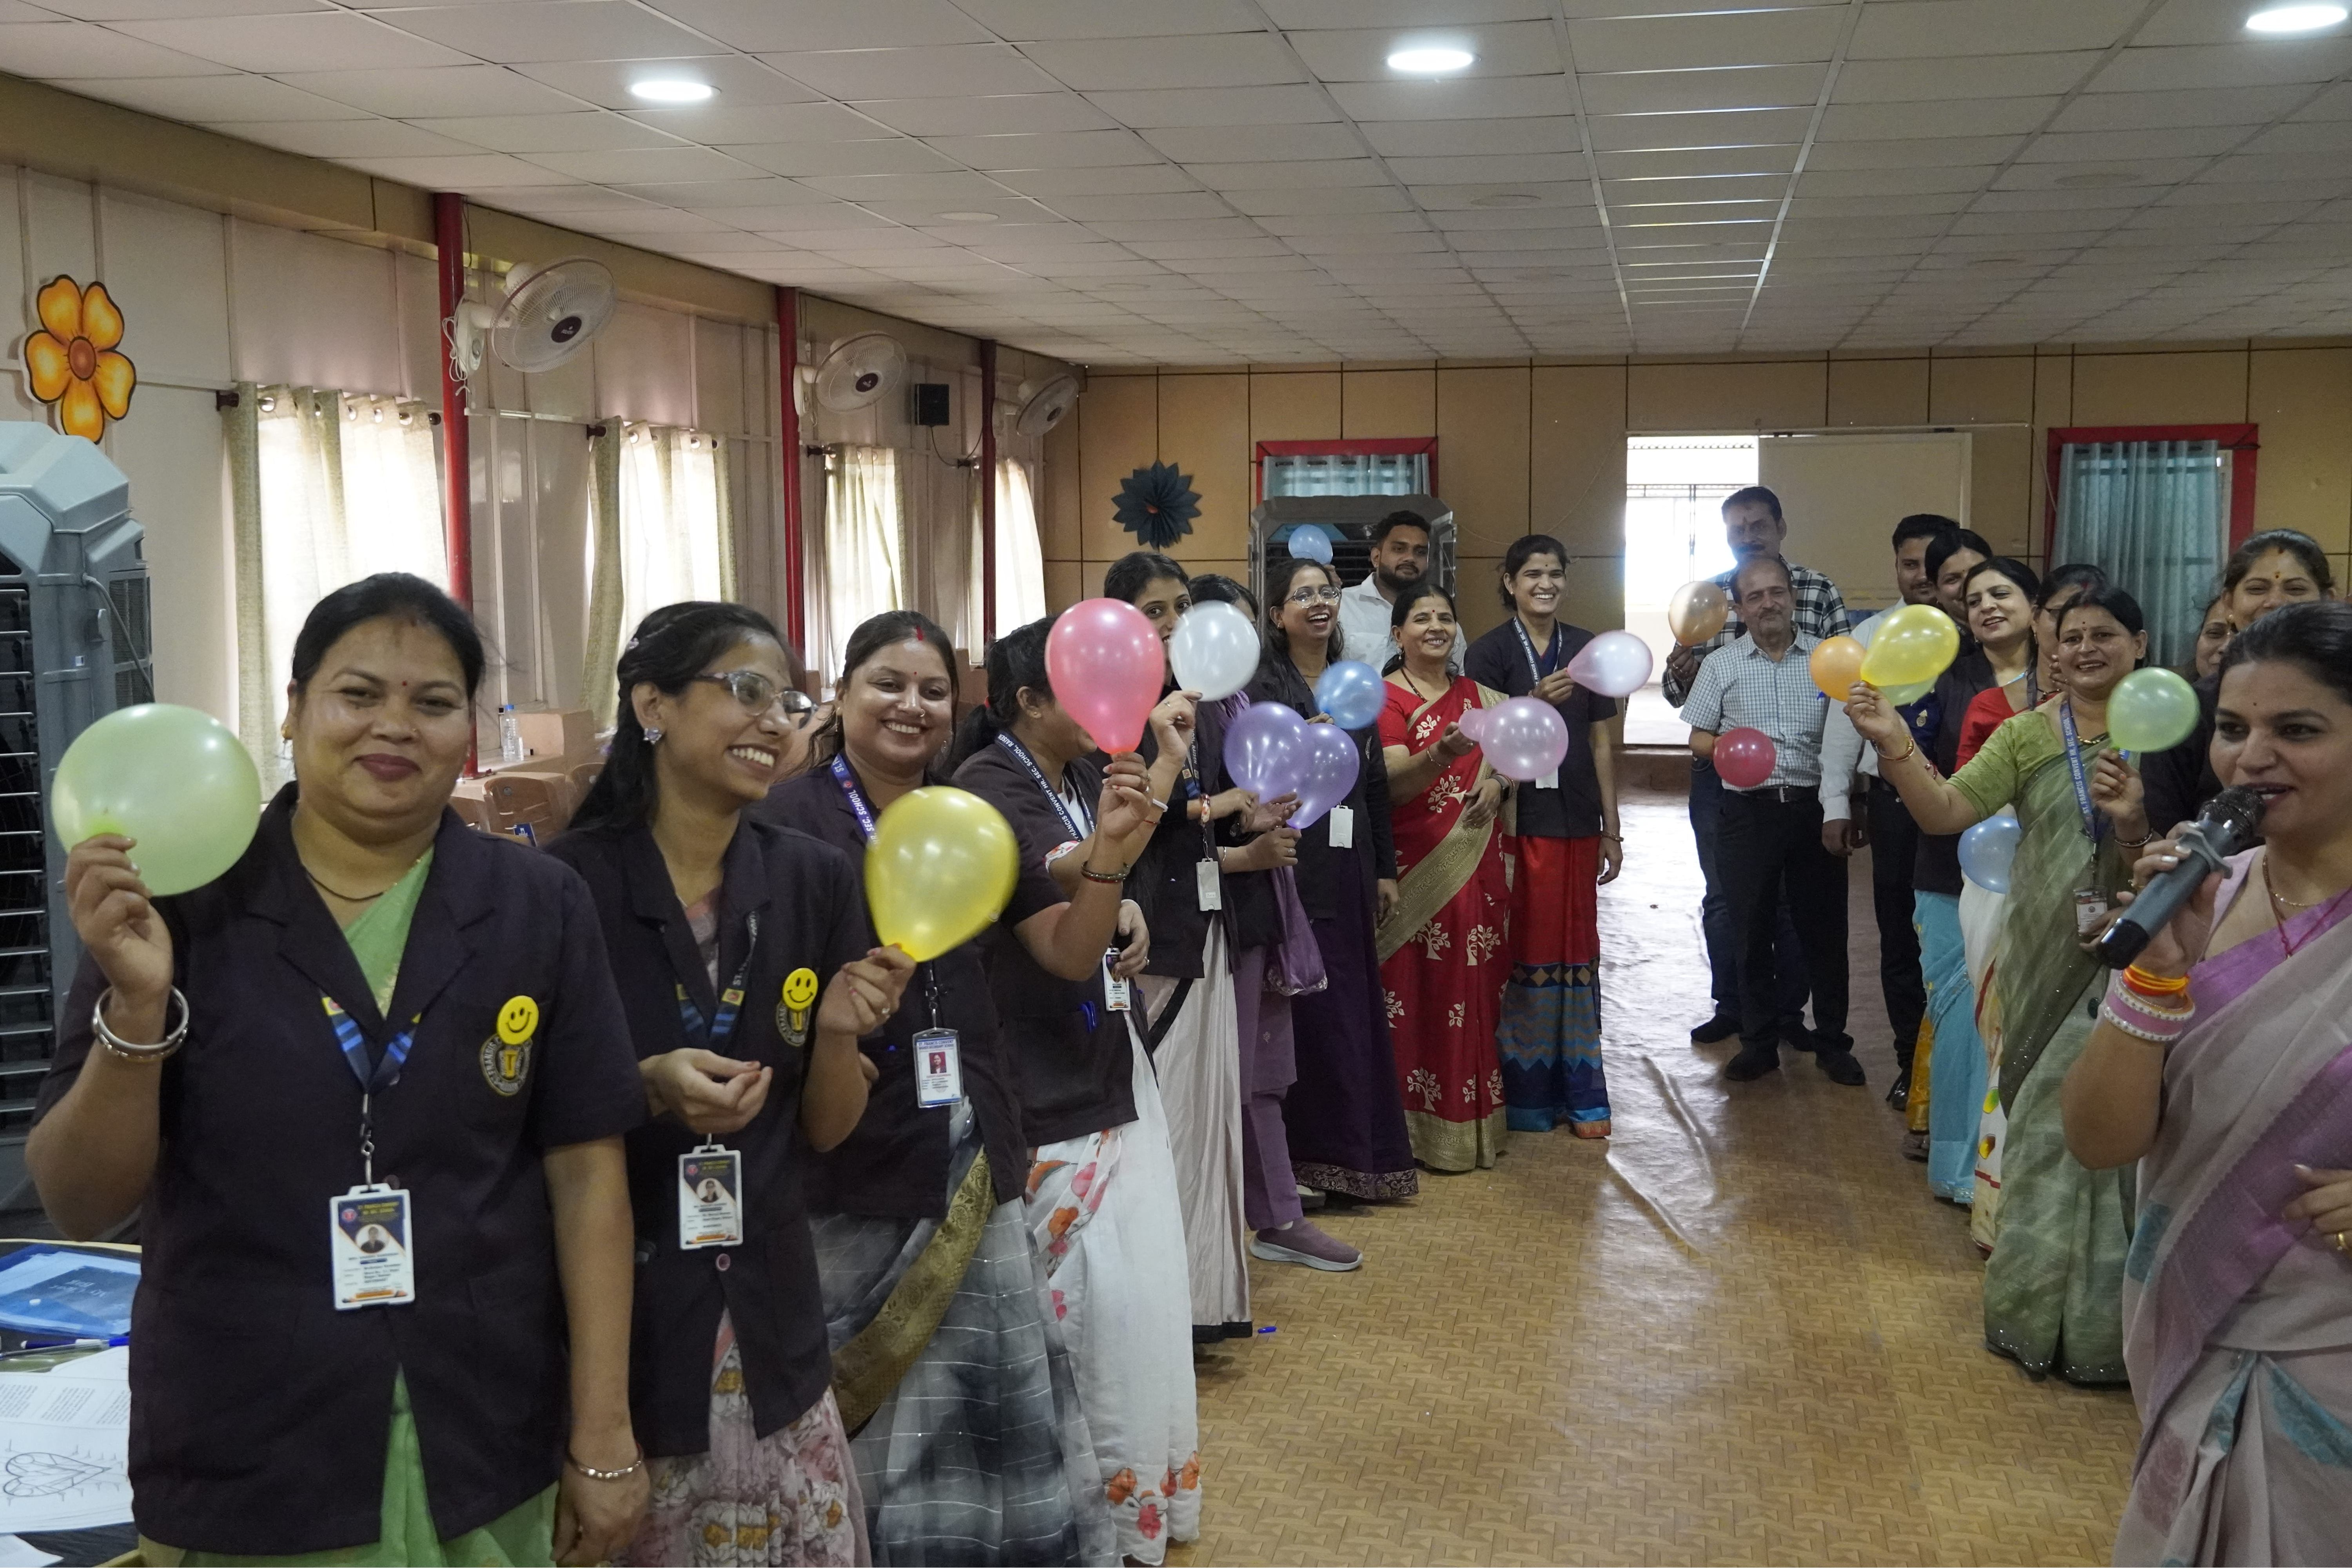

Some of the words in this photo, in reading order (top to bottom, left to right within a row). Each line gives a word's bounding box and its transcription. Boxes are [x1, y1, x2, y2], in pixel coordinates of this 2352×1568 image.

[1526, 645, 1534, 663] CONVENT
[2063, 717, 2073, 735] SCHOOL
[998, 733, 1014, 748] RAISEN
[1013, 745, 1033, 766] SCHOOL,
[834, 763, 844, 773] ST.
[1031, 766, 1041, 779] SEC.
[2071, 757, 2081, 780] CONVENT
[2077, 781, 2086, 803] FRANCIS
[848, 789, 867, 815] SCHOOL
[1046, 789, 1064, 815] CONVENT
[862, 816, 875, 832] SEC.
